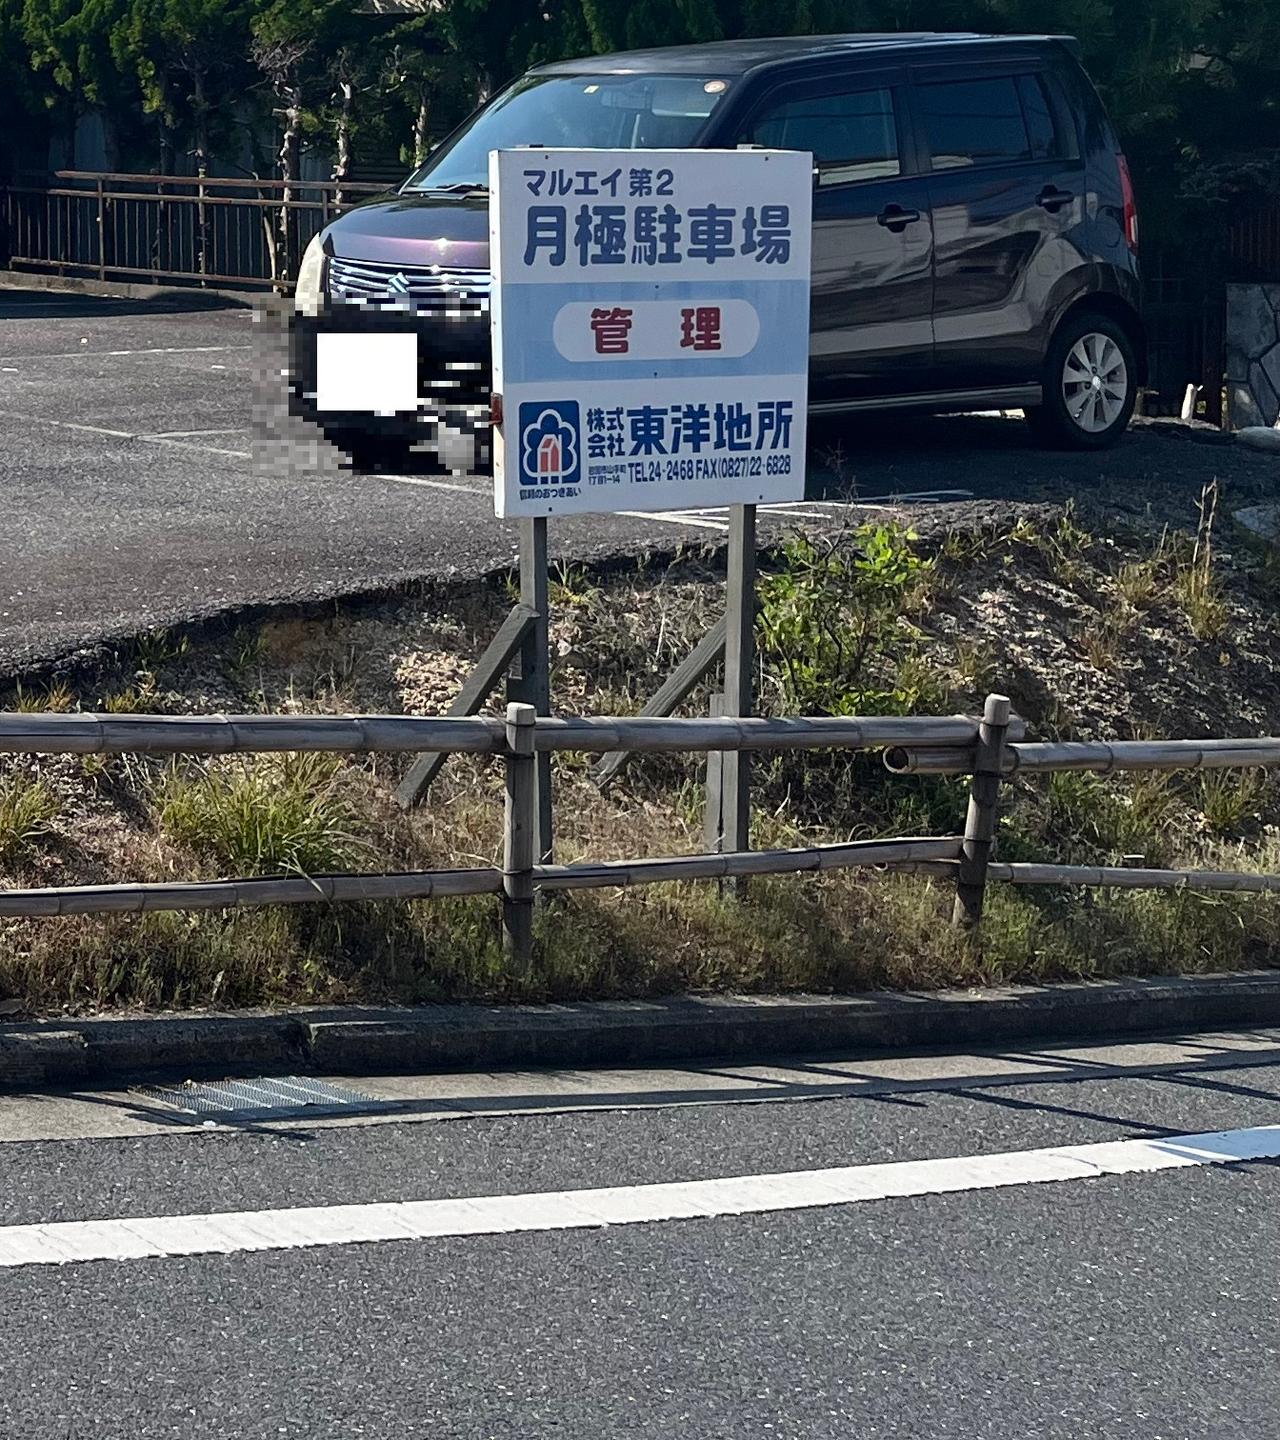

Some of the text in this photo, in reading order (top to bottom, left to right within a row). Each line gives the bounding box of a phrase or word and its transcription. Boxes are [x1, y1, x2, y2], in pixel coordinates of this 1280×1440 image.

[523, 168, 674, 197] マルエイ第2
[523, 203, 792, 266] 月極駐車場
[627, 401, 793, 456] 東洋地所
